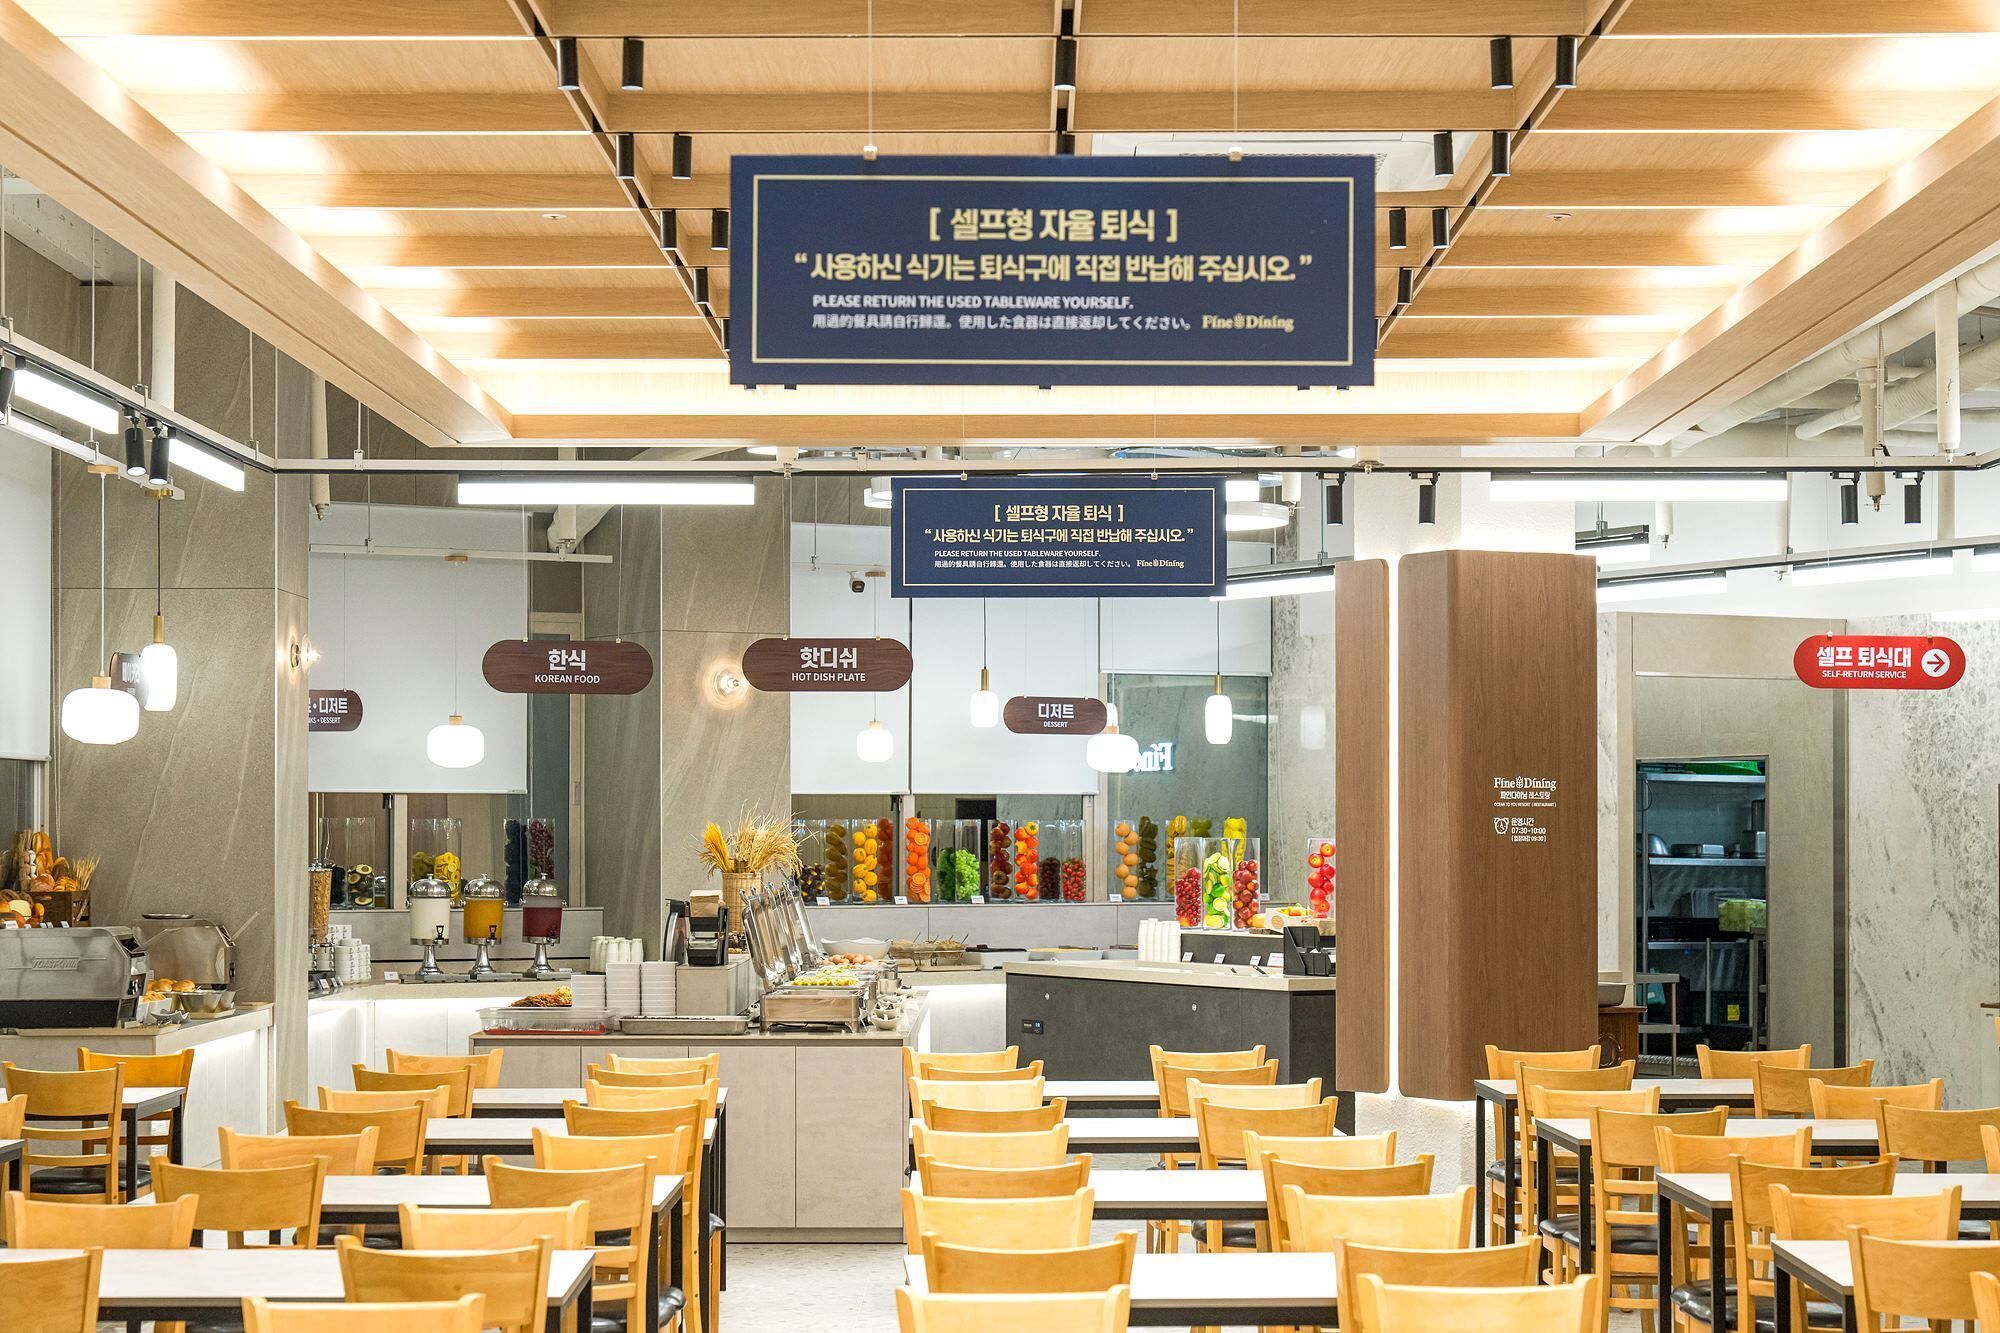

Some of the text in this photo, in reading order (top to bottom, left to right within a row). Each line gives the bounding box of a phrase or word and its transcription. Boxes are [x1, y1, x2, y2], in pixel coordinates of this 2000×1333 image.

[949, 207, 1034, 242] 셀프형
[1038, 208, 1096, 242] 자율
[1100, 208, 1155, 242] 퇴식
[905, 253, 976, 282] 식기는
[979, 254, 1071, 282] 퇴식구에
[1074, 254, 1121, 282] 직접
[1125, 254, 1194, 282] 반납해
[812, 294, 1134, 310] PLEASE RETURN THE USED TABLEWARE YOURSELF.
[1202, 313, 1295, 333] Fine Dining
[1005, 504, 1049, 522] 셀프형
[1051, 504, 1081, 522] 자율
[1083, 504, 1112, 522] 퇴식
[982, 528, 1019, 543] 식기는
[1020, 528, 1068, 543] 퇴식구에
[1070, 528, 1094, 543] 직접
[1096, 528, 1133, 543] 반납해
[1022, 550, 1064, 558] TABLEWARE
[1063, 550, 1102, 558] YOURSELF.
[1136, 559, 1185, 569] Fine Dining
[548, 648, 586, 671] 한식
[799, 646, 858, 669] 핫디쉬
[1816, 646, 1912, 668] 셀프 퇴식대
[534, 674, 601, 684] KOREAN FOOD
[791, 672, 866, 682] HOT DISH PLATE
[1822, 670, 1907, 679] SELF-RETURN SERVICE
[319, 697, 348, 714] 디저트
[1038, 703, 1075, 719] 디저트
[319, 716, 341, 724] DESSERT
[1043, 720, 1068, 728] DESSERT
[1493, 776, 1557, 792] Fine Dining
